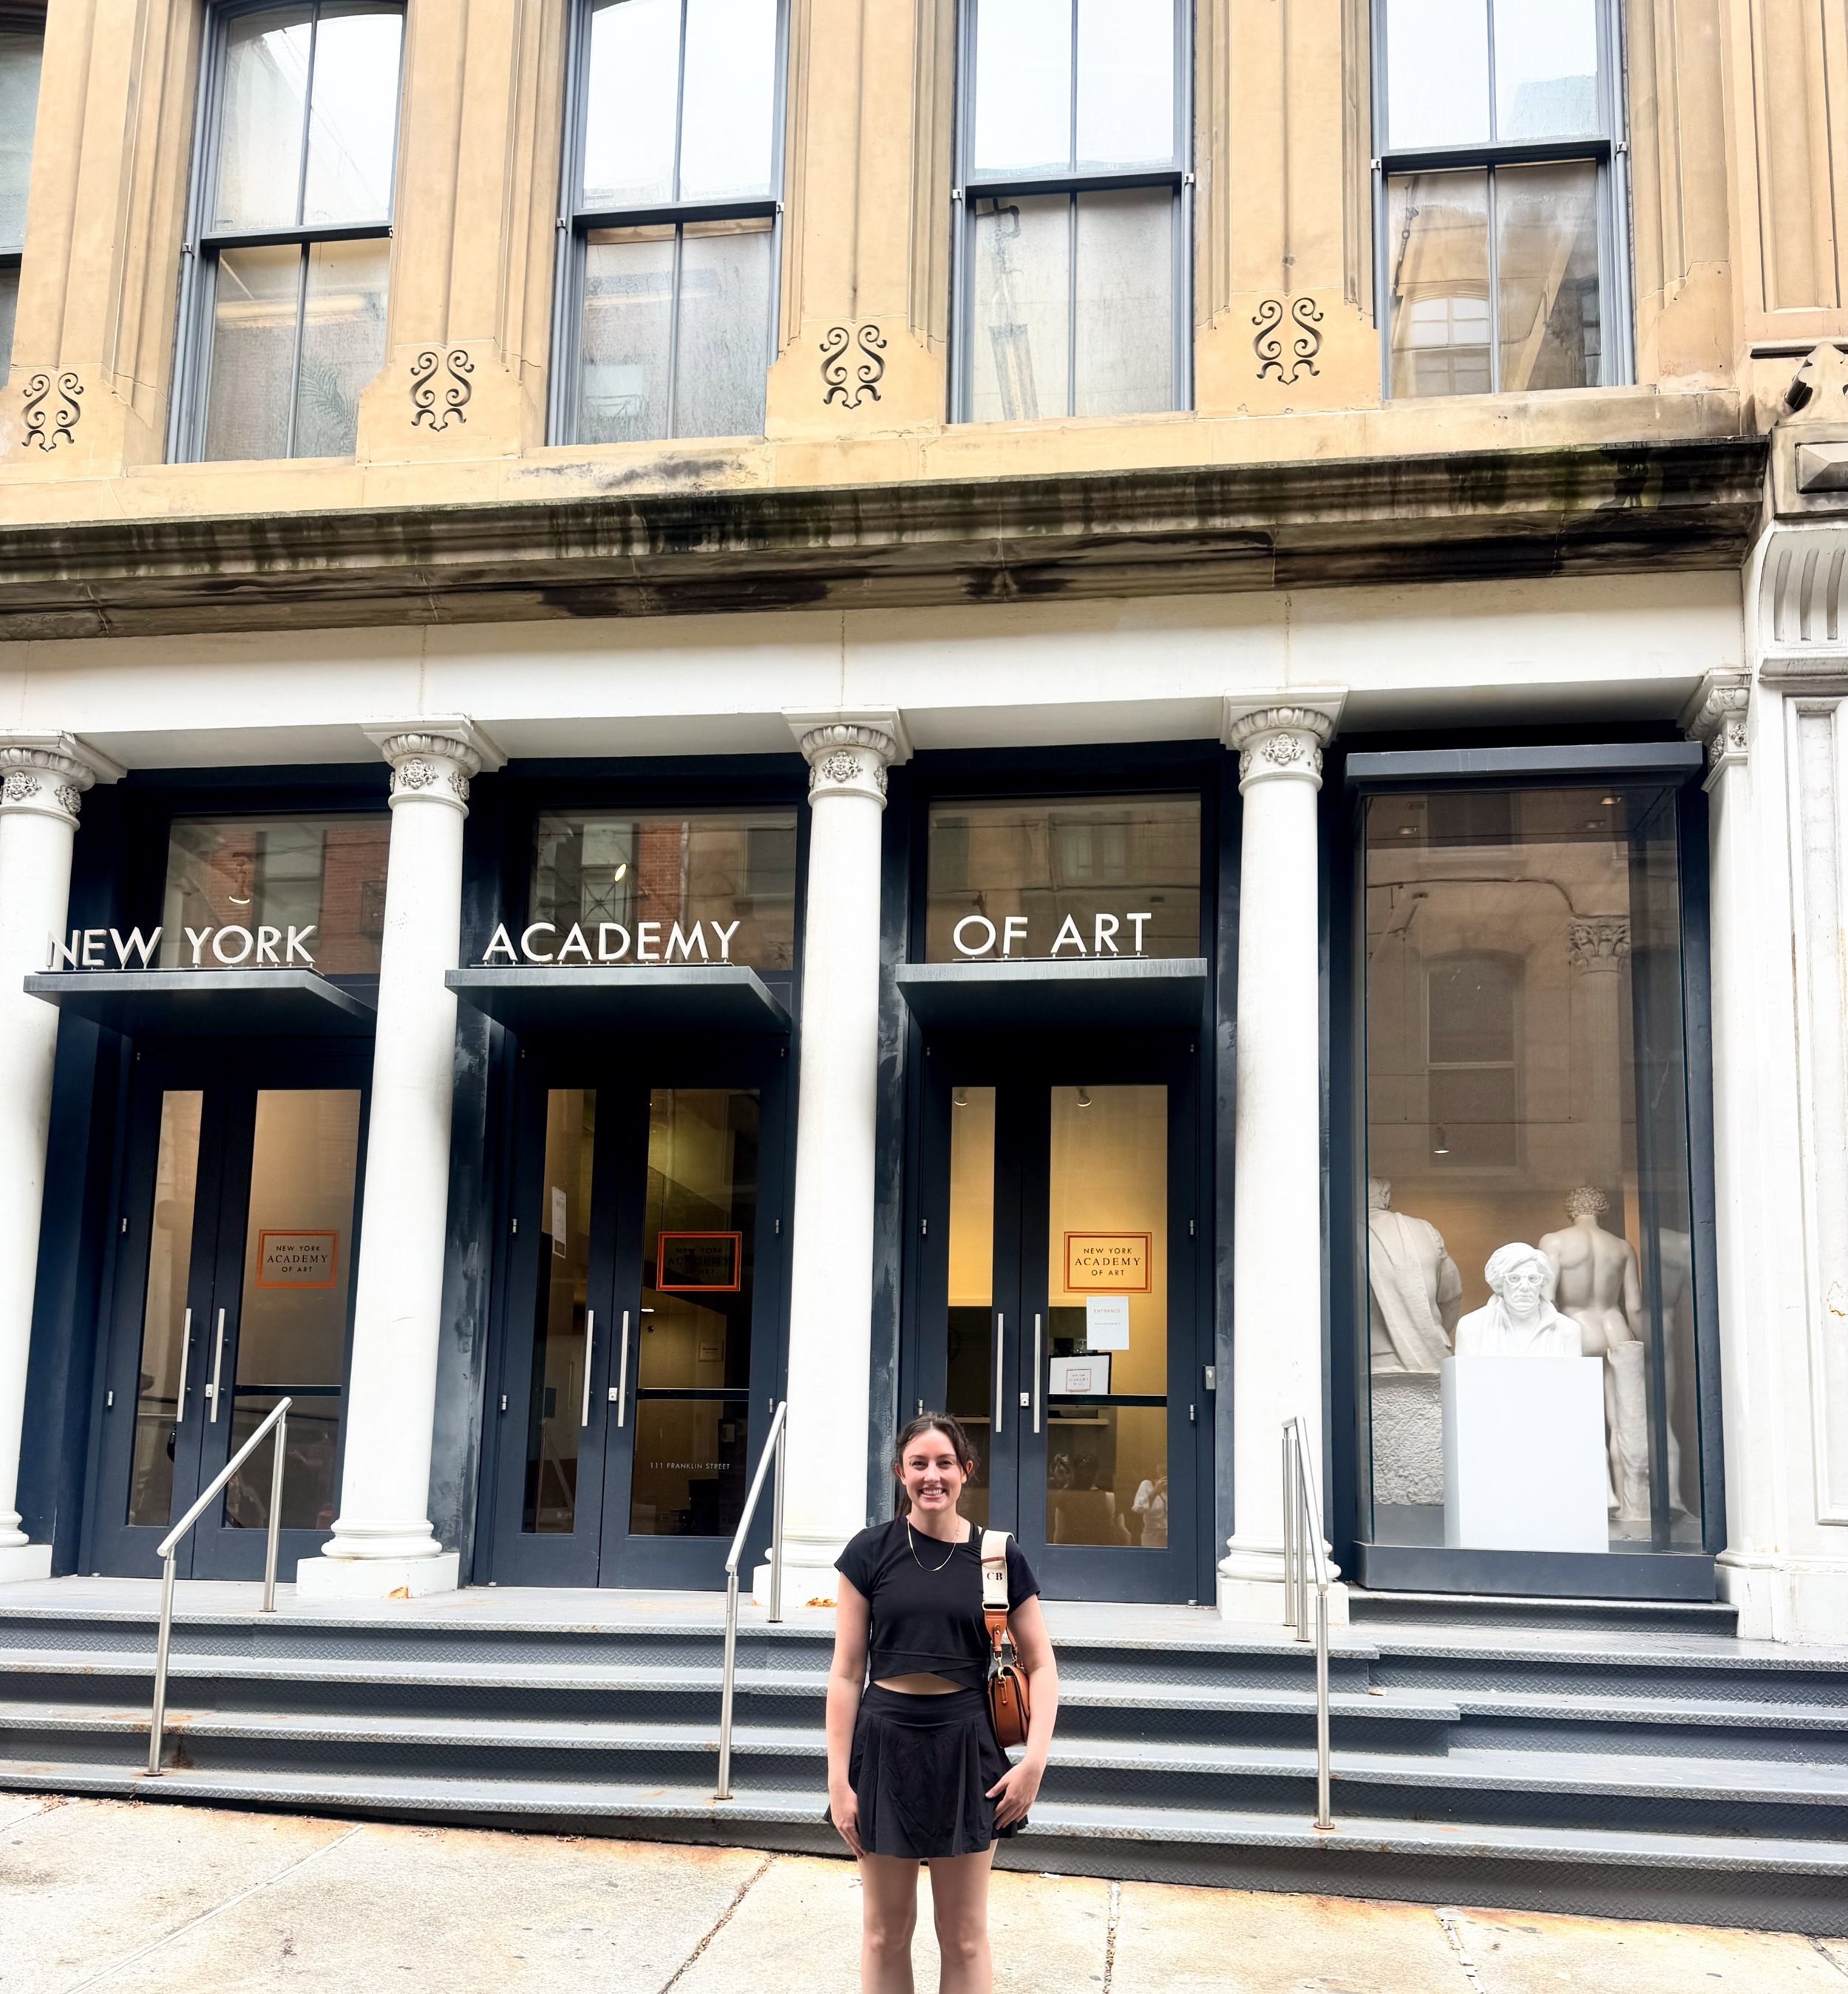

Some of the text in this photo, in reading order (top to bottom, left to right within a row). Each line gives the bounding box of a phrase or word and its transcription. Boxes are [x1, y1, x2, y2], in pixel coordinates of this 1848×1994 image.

[47, 925, 318, 967] NEW YORK
[482, 920, 740, 962] ACADEMY
[953, 913, 1152, 956] OF ART
[267, 1255, 328, 1263] ACADEMY
[1075, 1257, 1141, 1266] ACADEMY
[987, 1572, 1003, 1580] CB
